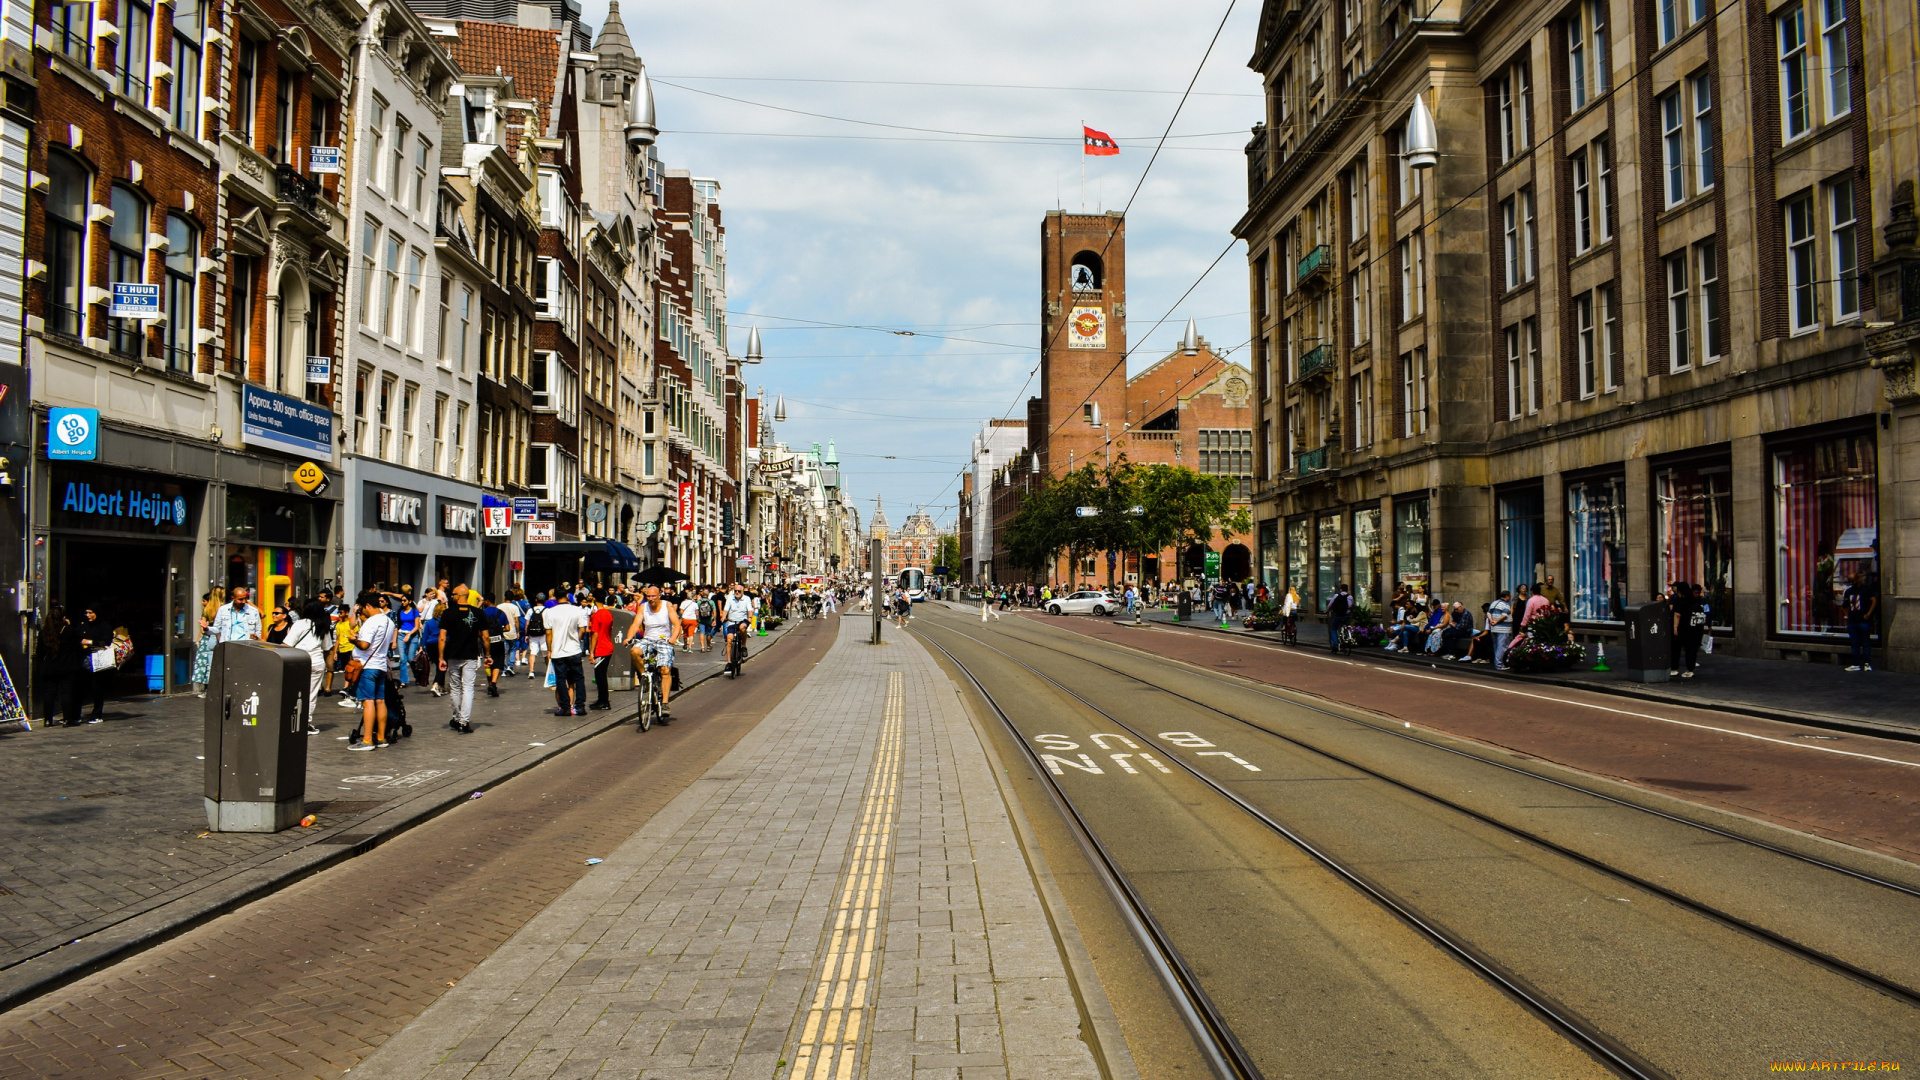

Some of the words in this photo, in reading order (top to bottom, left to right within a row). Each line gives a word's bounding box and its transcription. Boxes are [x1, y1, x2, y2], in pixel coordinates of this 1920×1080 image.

[130, 286, 154, 294] HUUR
[248, 392, 272, 409] Approx.
[272, 400, 284, 413] 500
[284, 406, 298, 418] sqm.
[299, 408, 314, 422] office
[314, 414, 330, 426] space
[248, 411, 258, 420] Units
[258, 414, 268, 422] from
[63, 418, 78, 430] to
[68, 426, 85, 442] go
[314, 484, 326, 494] cash
[63, 482, 124, 516] Albert
[128, 490, 170, 526] Heijn
[174, 500, 182, 511] to
[391, 494, 421, 526] KFC
[176, 508, 185, 524] go
[452, 506, 476, 534] KFC
